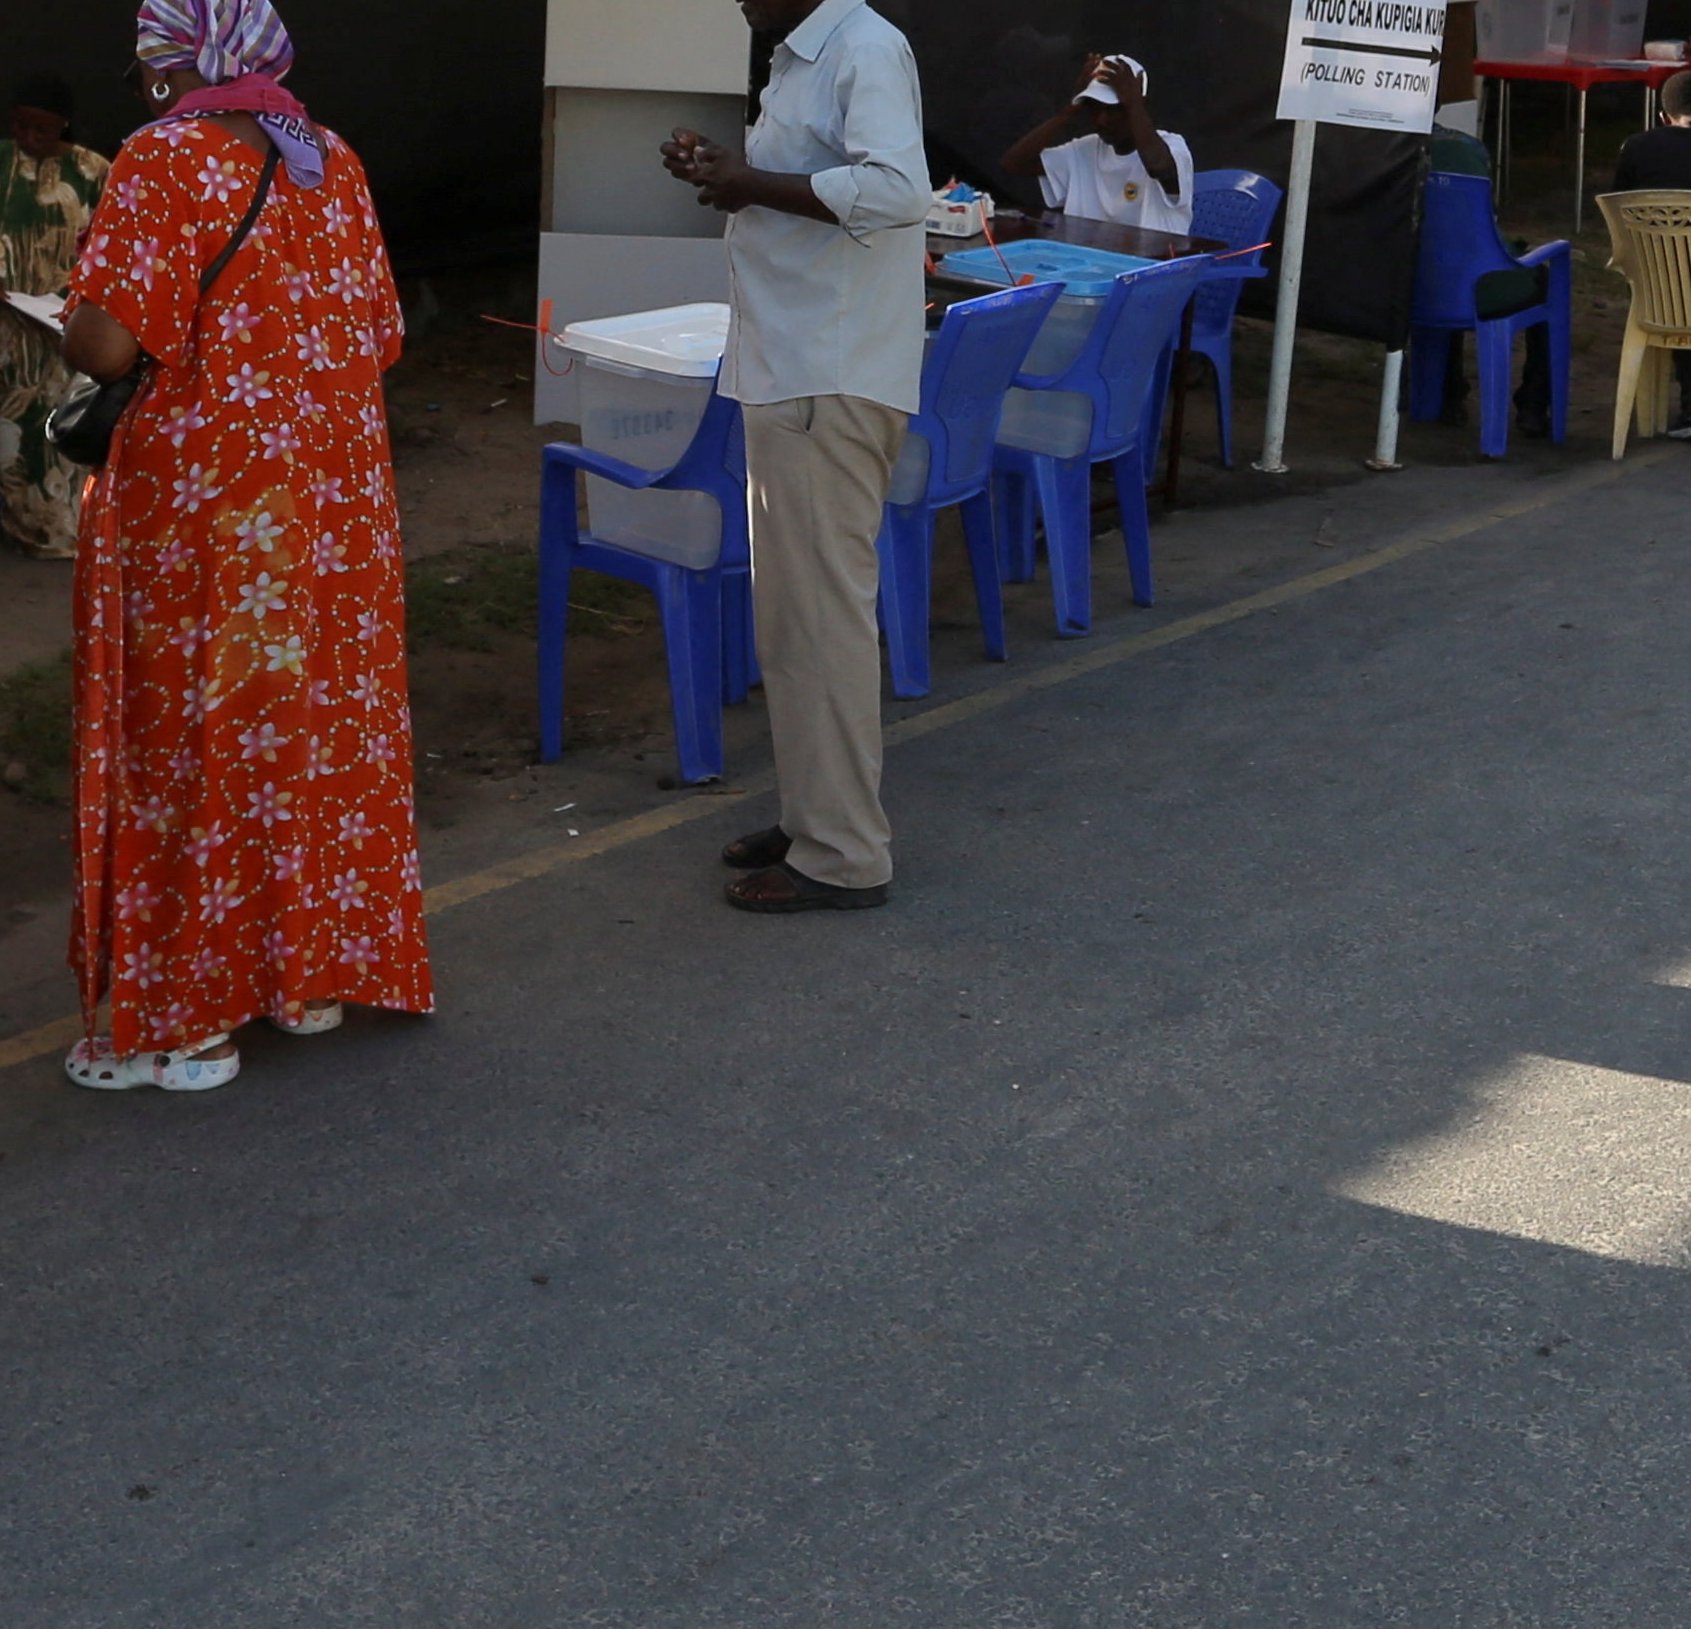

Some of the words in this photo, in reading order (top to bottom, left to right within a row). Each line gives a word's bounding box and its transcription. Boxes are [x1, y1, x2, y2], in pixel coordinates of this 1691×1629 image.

[1374, 1, 1422, 34] KUPIGIA
[1424, 7, 1445, 37] KUR
[1300, 62, 1366, 86] (POLLING
[1374, 70, 1431, 98] STATION)
